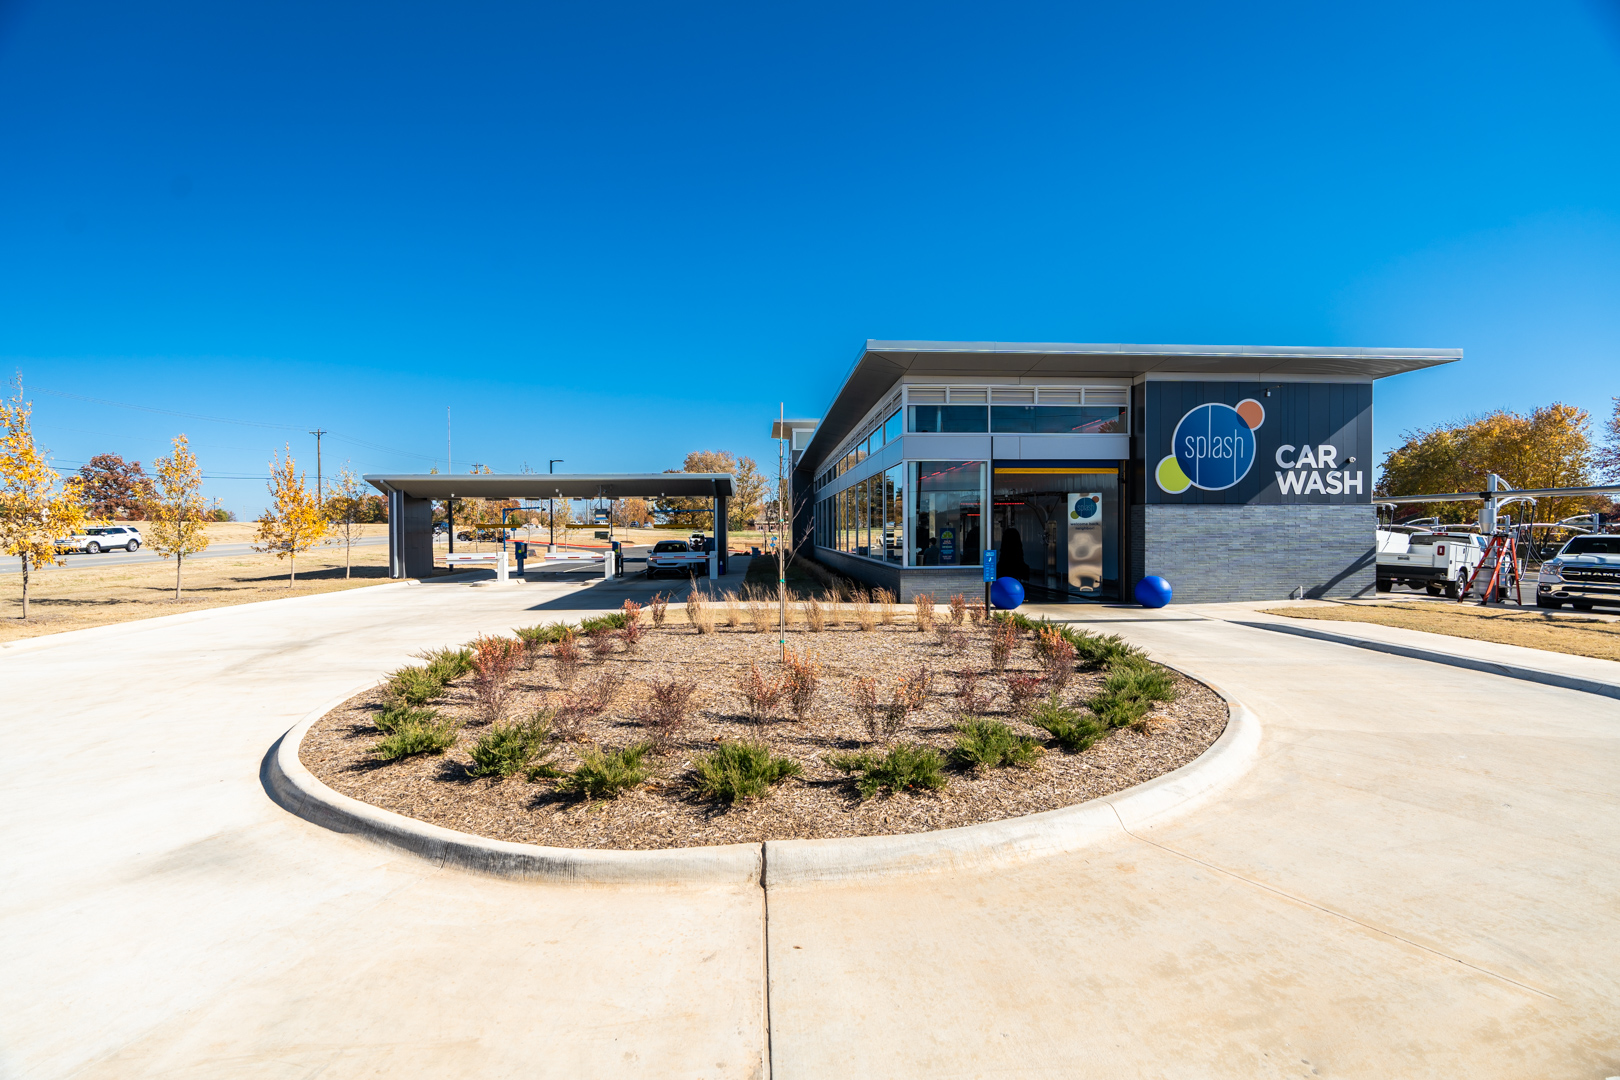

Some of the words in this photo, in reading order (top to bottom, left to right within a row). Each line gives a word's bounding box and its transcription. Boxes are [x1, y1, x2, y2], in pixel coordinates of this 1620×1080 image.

[1185, 405, 1244, 485] splash
[1275, 444, 1337, 469] CAR
[1275, 470, 1363, 495] WASH
